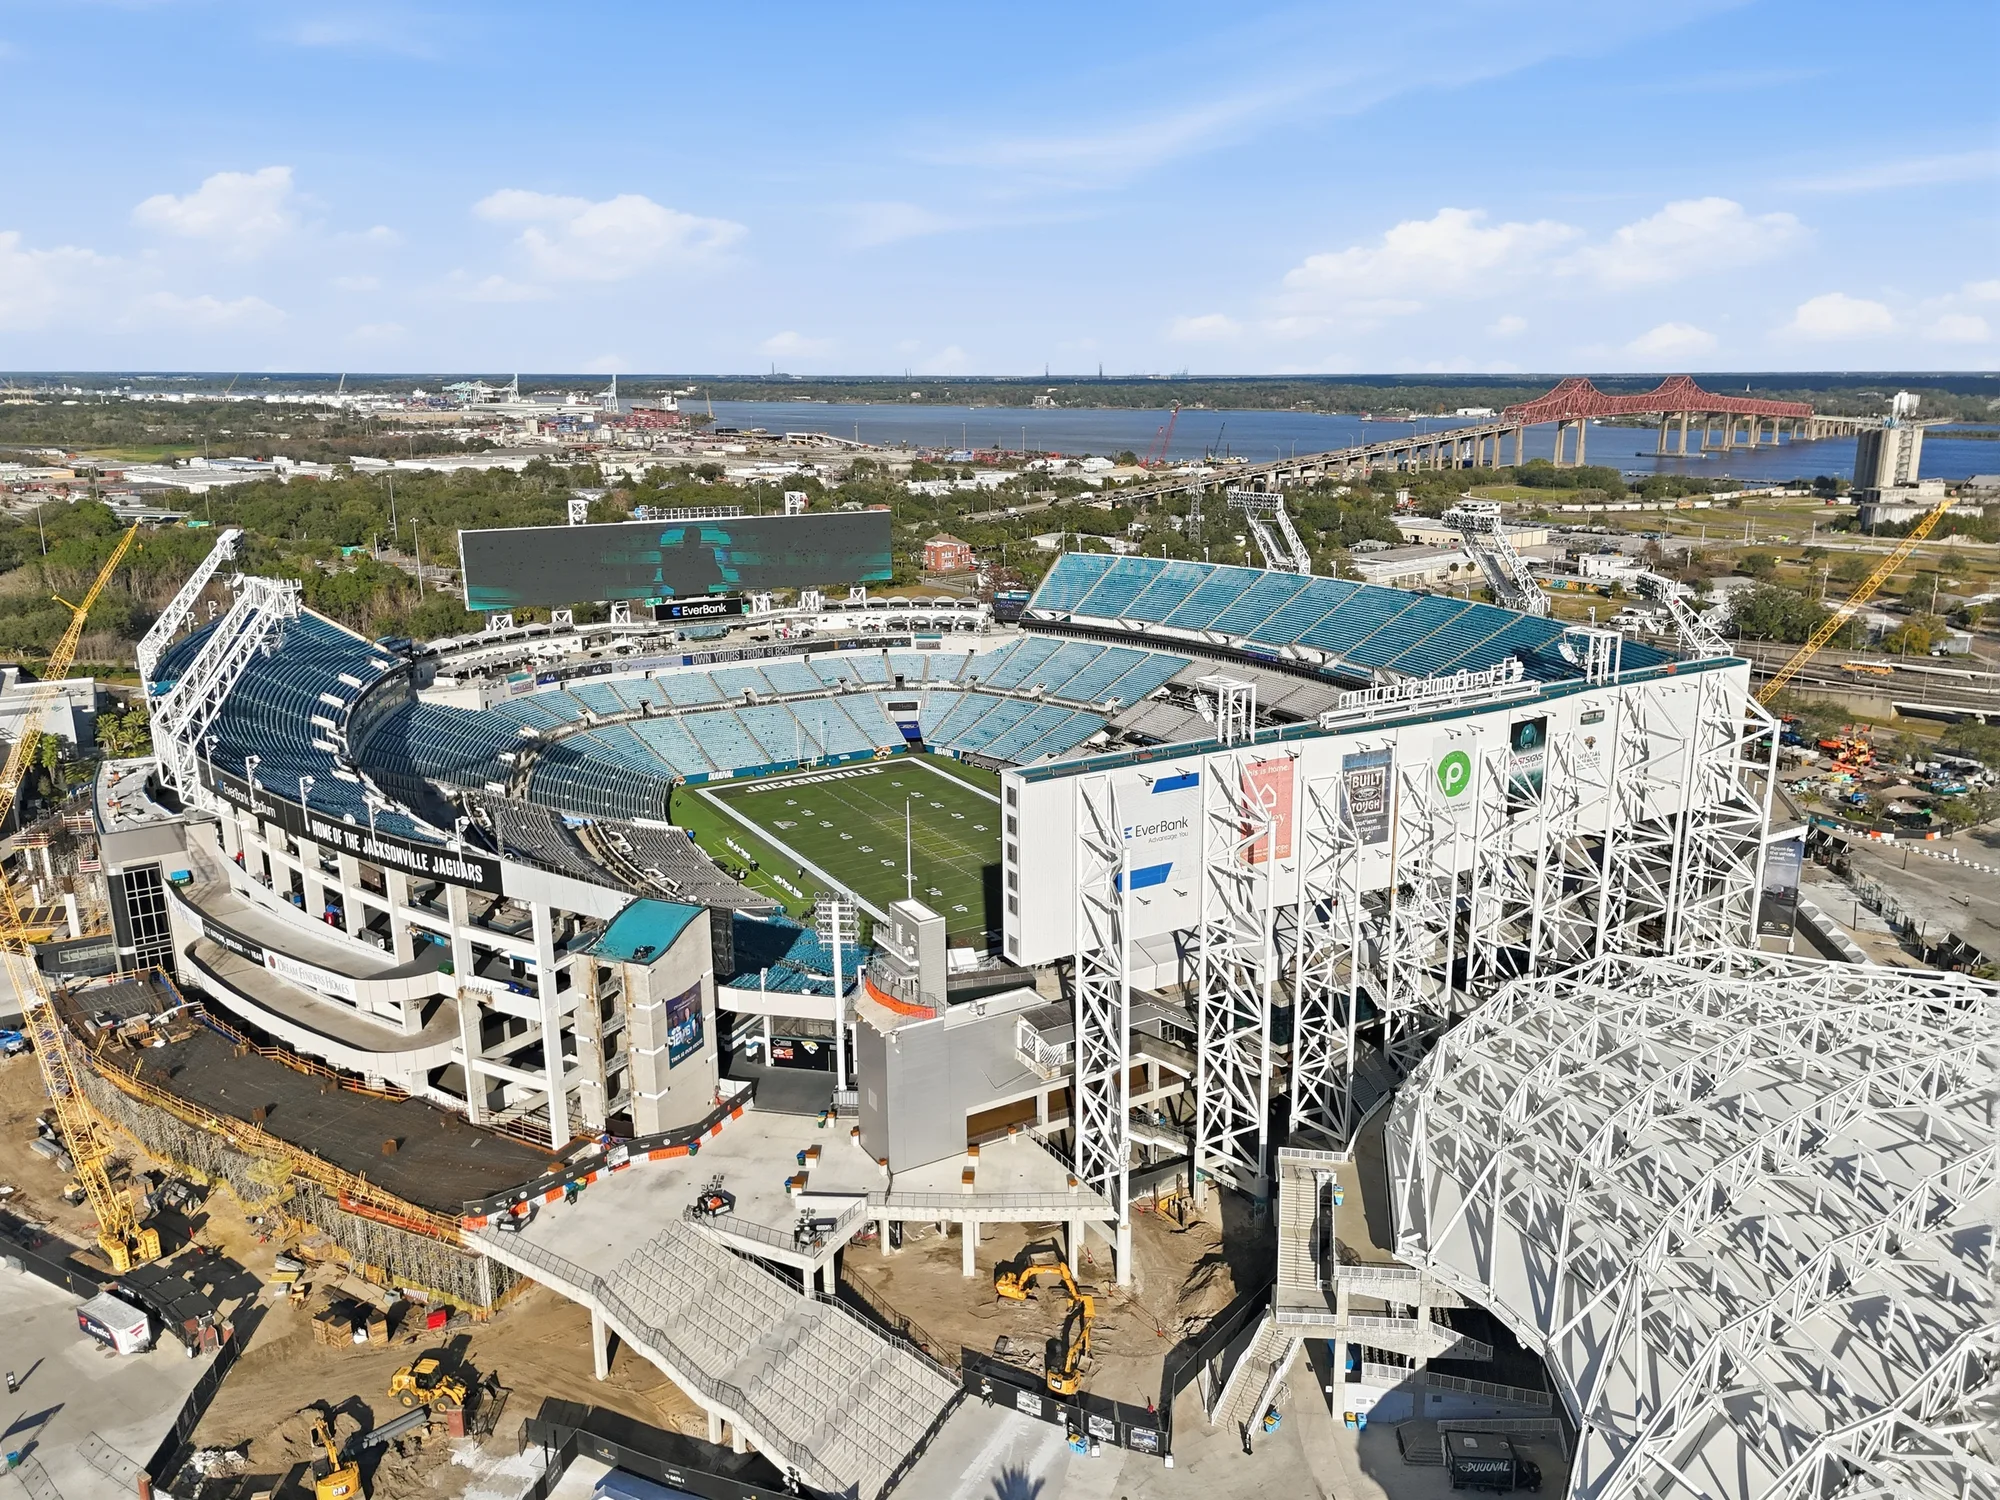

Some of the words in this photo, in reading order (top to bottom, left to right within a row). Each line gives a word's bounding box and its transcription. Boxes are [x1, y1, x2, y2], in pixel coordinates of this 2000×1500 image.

[682, 603, 727, 616] EverBank
[692, 654, 712, 665] OWN
[714, 651, 740, 663] YOURS
[742, 648, 764, 660] FROM
[745, 766, 885, 793] JACKSONVILLE
[1352, 773, 1381, 788] BUILT
[223, 782, 249, 805] EverBank
[1351, 799, 1380, 813] TOUGH
[1135, 816, 1188, 837] EverBank
[312, 820, 333, 841] HOME
[332, 828, 343, 845] OF
[344, 832, 361, 851] THE
[362, 839, 429, 872] JACKSONVILLE
[432, 856, 483, 883] JAGUARS
[277, 958, 298, 977] DREAM
[298, 967, 325, 986] FINDERS
[325, 975, 350, 995] HOMES
[87, 1321, 111, 1340] Fanatics
[332, 1485, 348, 1496] CAT
